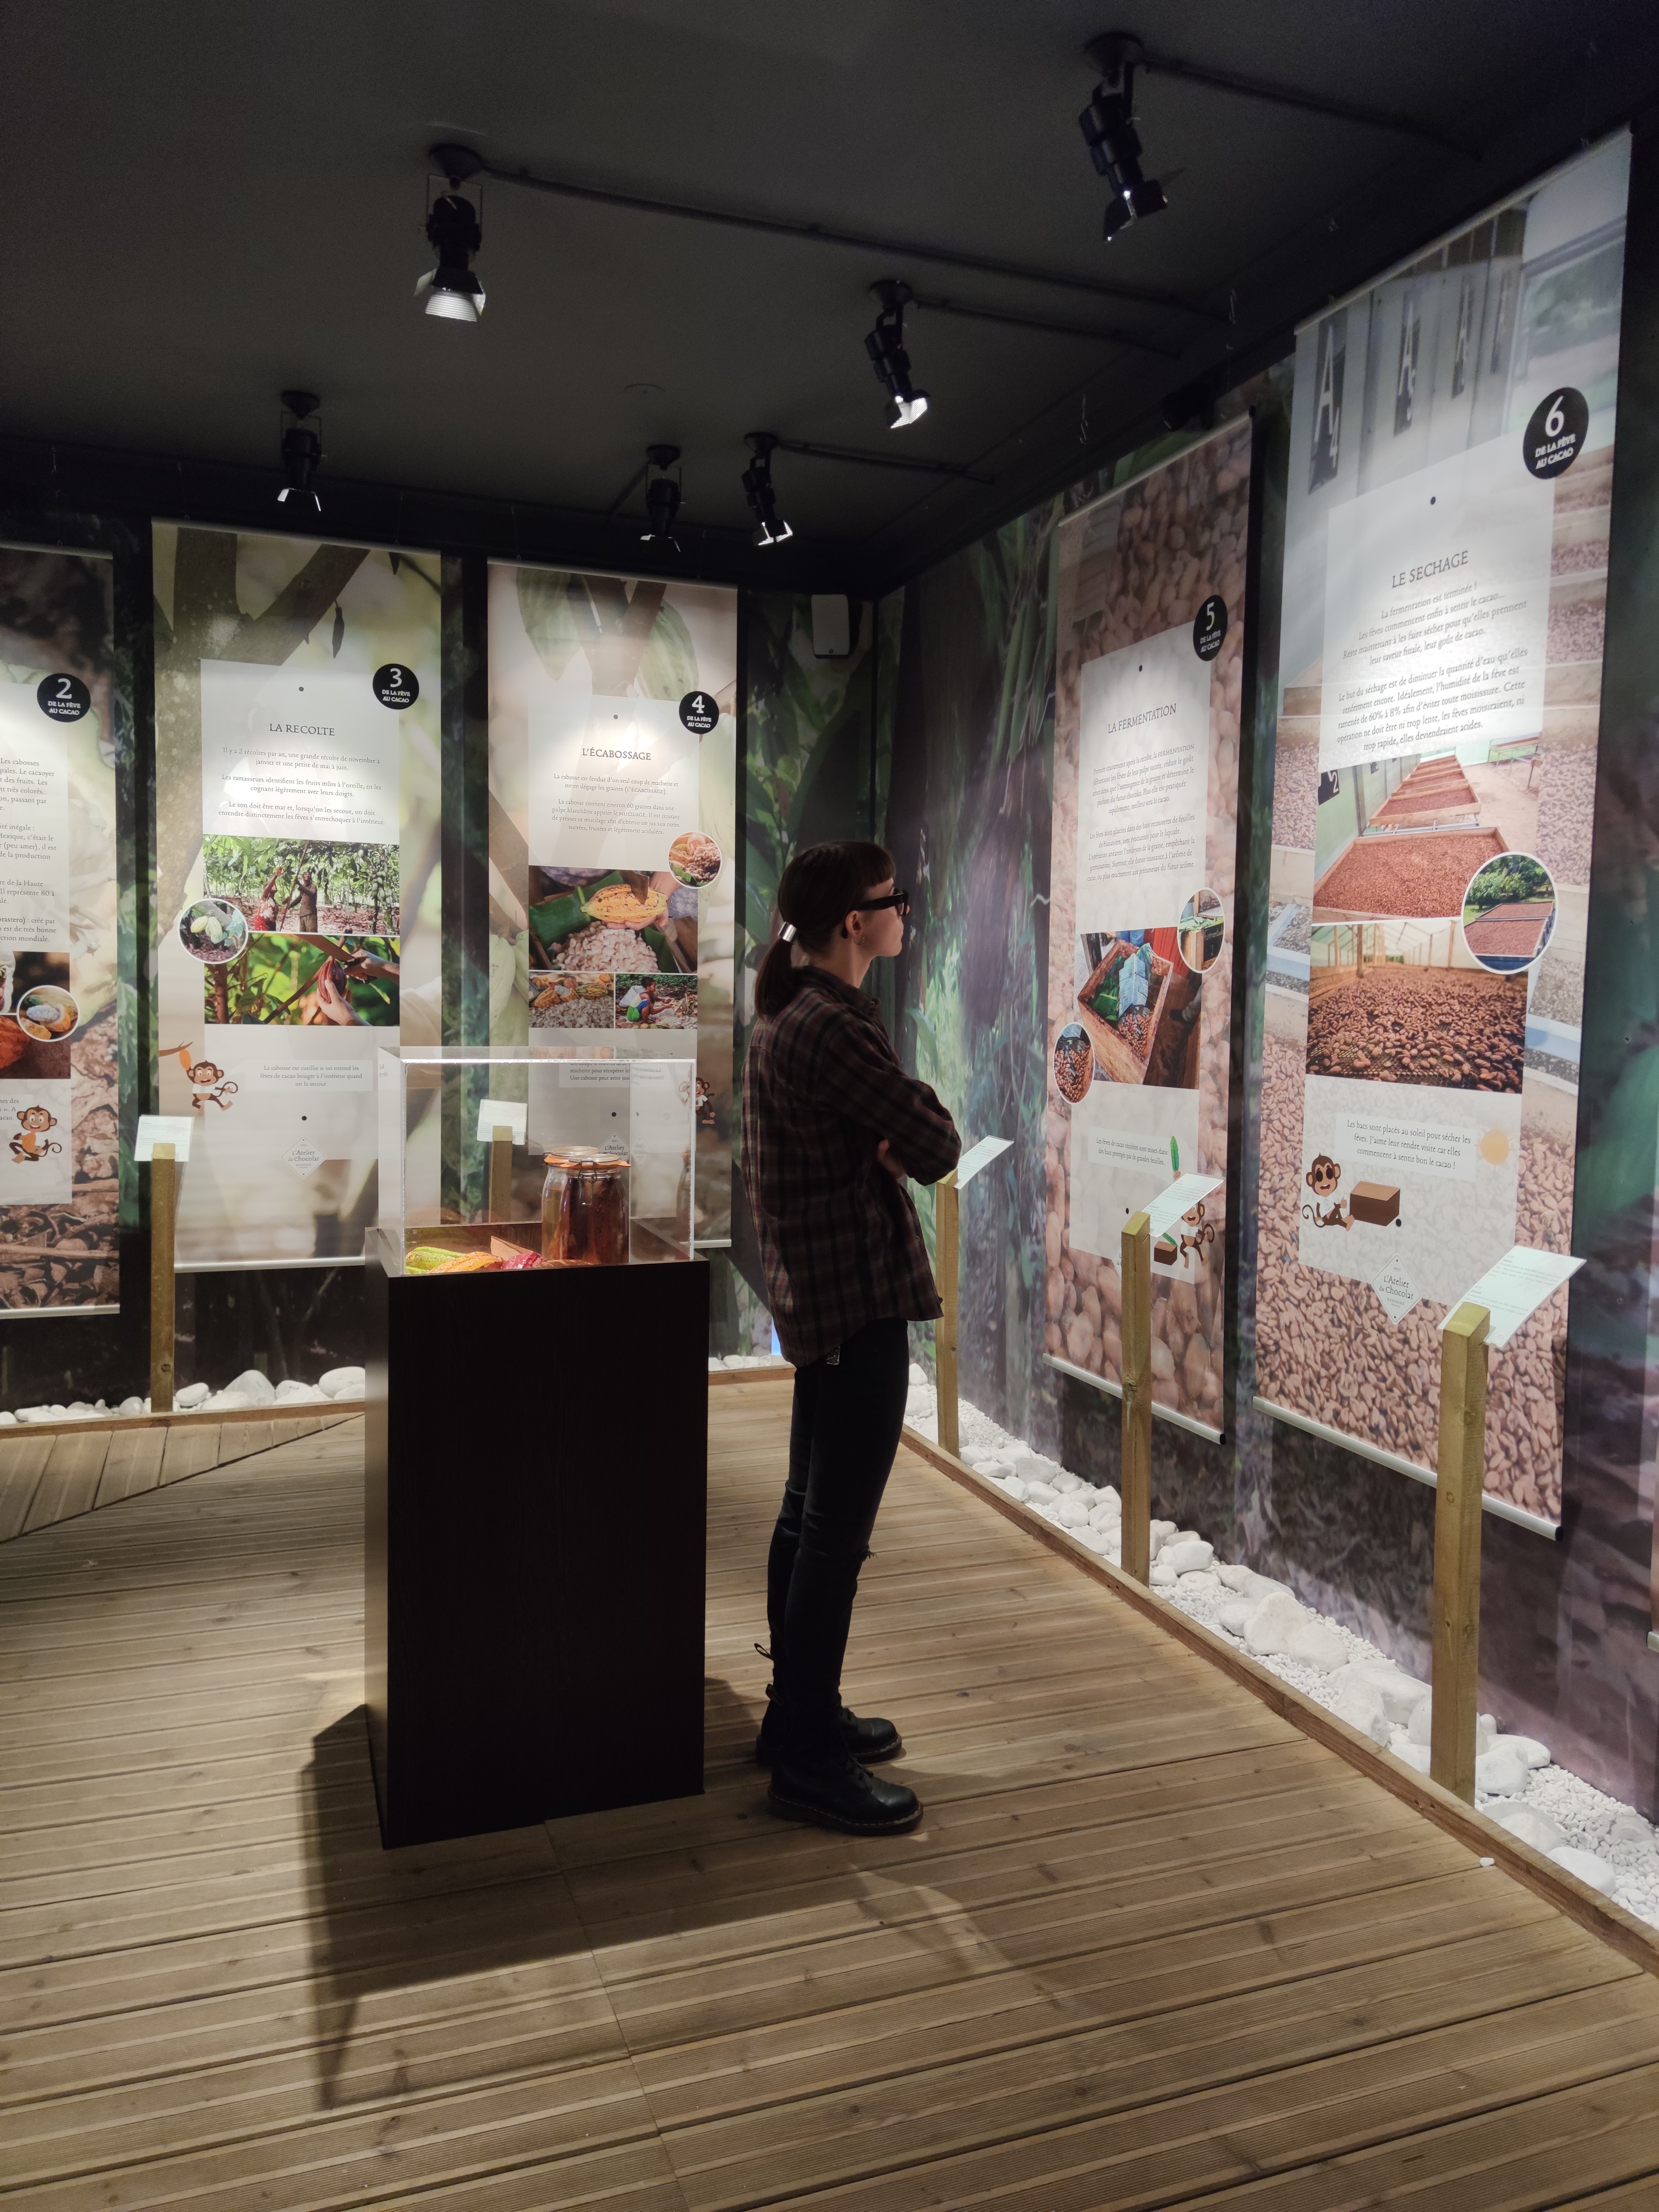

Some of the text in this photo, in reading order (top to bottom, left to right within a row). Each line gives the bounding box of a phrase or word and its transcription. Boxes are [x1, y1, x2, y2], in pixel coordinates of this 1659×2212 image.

[1545, 395, 1564, 437] 6
[1535, 445, 1546, 457] DE
[1547, 442, 1556, 452] LA
[1535, 447, 1574, 469] AU CACAO
[1391, 550, 1468, 589] LE SECHAGE
[1206, 602, 1215, 631] 5
[1207, 639, 1220, 650] CACAO
[390, 668, 402, 688] 3
[1338, 649, 1528, 702] Le but du séchage est de diminuer la quantité d'eau qu'elles
[56, 678, 72, 699] 2
[692, 695, 705, 713] 4
[1108, 703, 1176, 734] LA FERMENTATION
[270, 723, 335, 736] LA RECOLTE
[582, 747, 651, 760] L'ÉCABOSSAGE
[1113, 828, 1126, 837] placées
[1357, 1120, 1367, 1129] bacs
[1382, 1124, 1399, 1135] placés
[1410, 1128, 1425, 1137] soleil
[1442, 1133, 1460, 1142] sécher
[1462, 1134, 1470, 1144] les
[1354, 1133, 1368, 1142] fèves.
[1370, 1135, 1387, 1145] J'aime
[1388, 1138, 1399, 1147] leur
[1401, 1141, 1419, 1150] rendre
[1421, 1143, 1435, 1152] visite
[1447, 1146, 1460, 1156] elles
[1357, 1149, 1392, 1159] commencent
[1416, 1155, 1427, 1164] bon
[1429, 1157, 1434, 1165] le
[1384, 1275, 1409, 1288] L'Atelier
[1385, 1285, 1413, 1299] Chocolat
